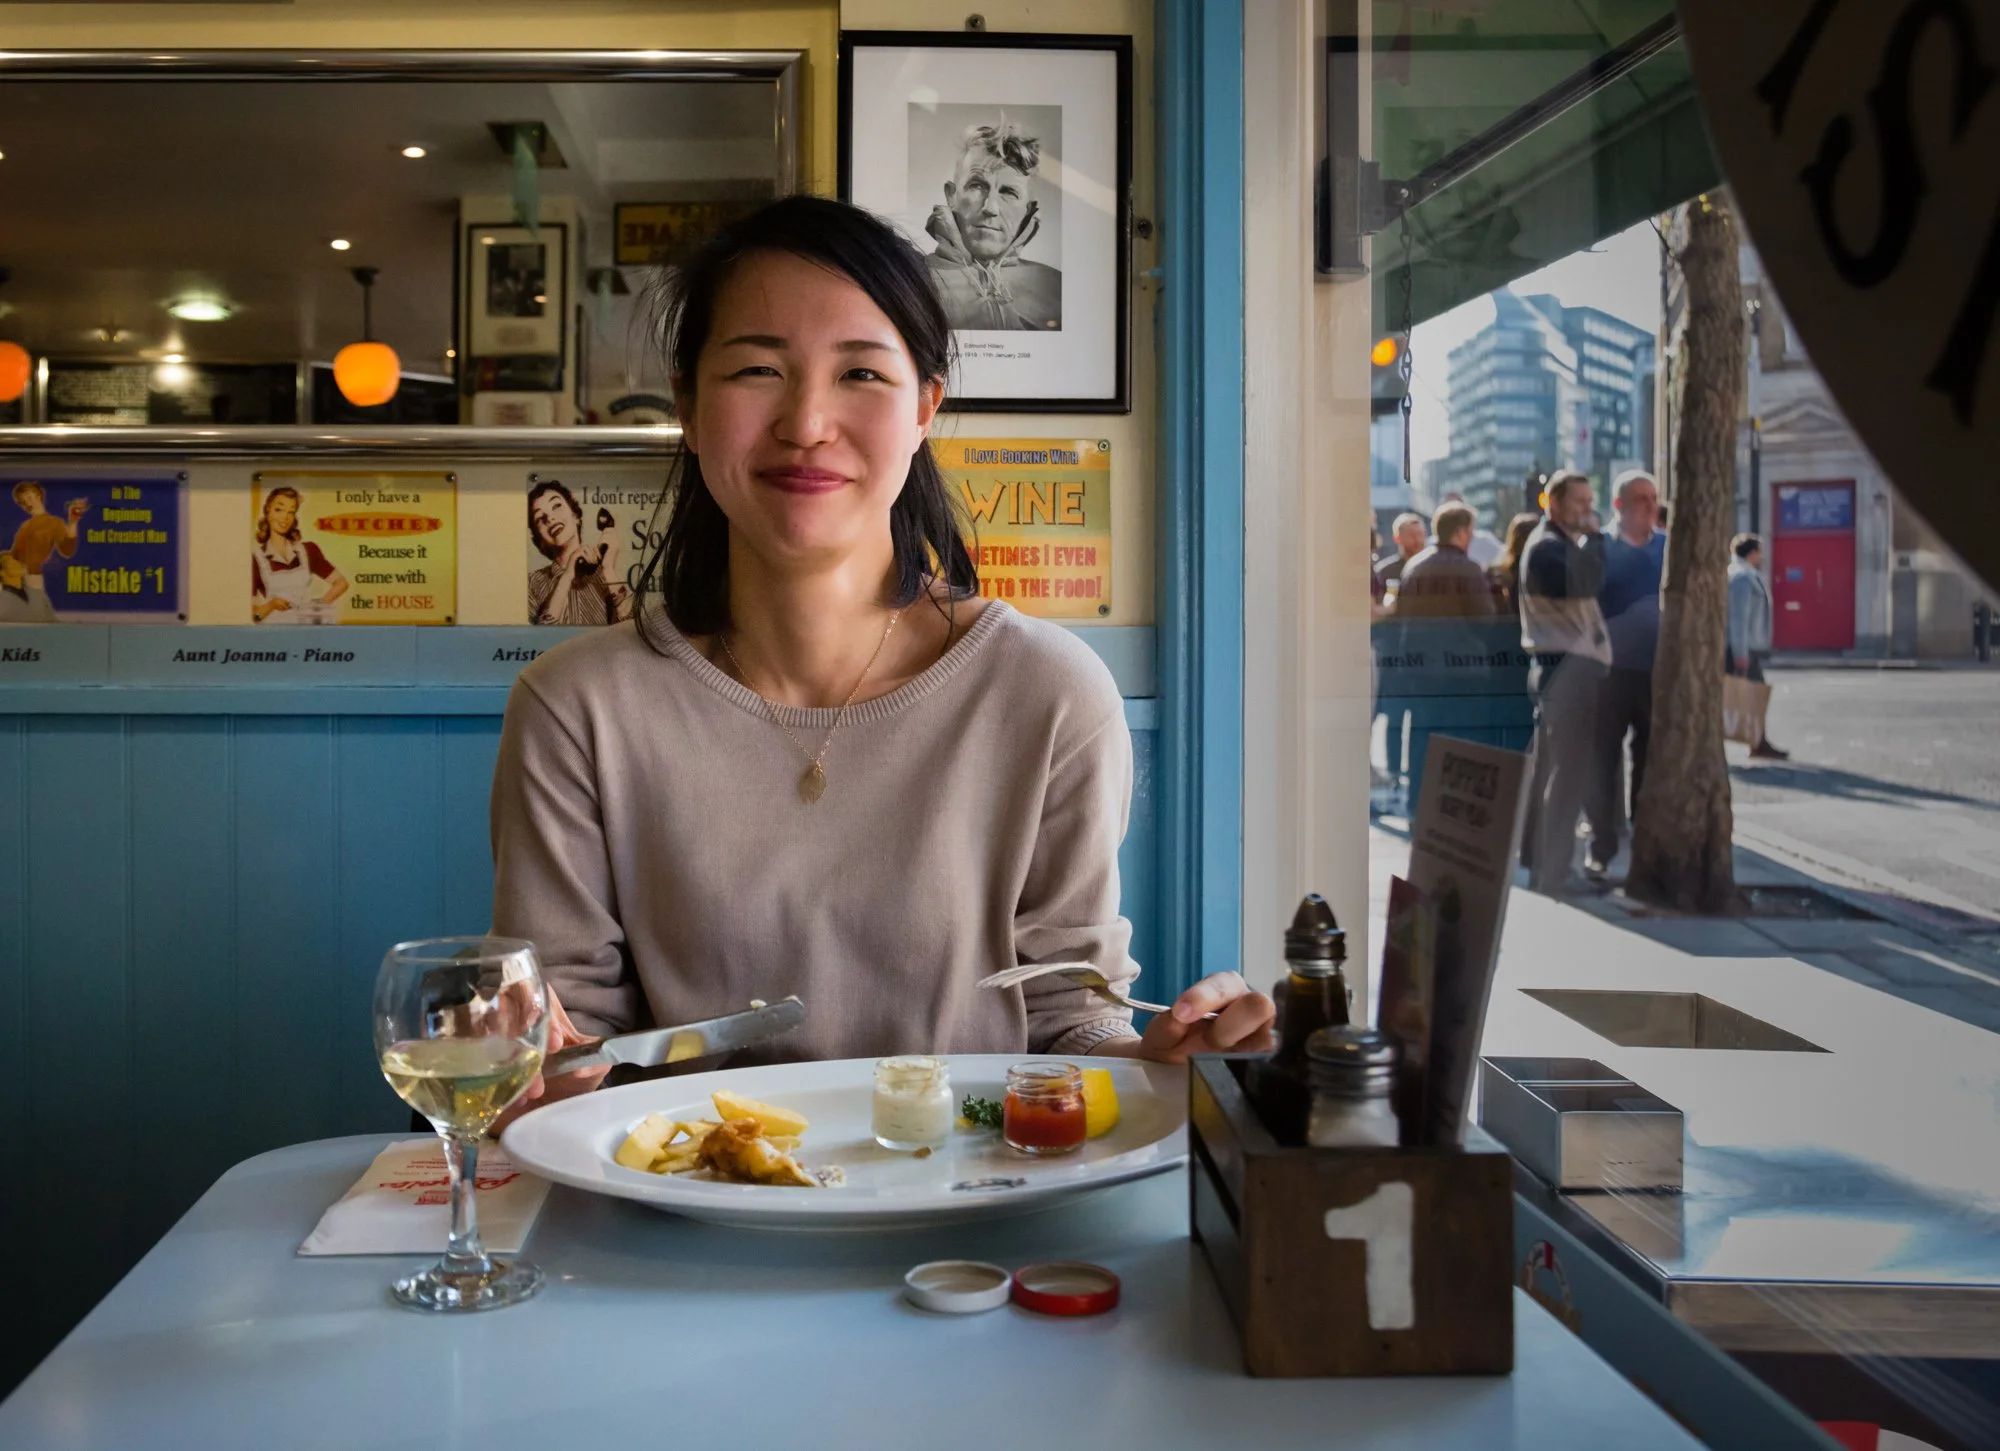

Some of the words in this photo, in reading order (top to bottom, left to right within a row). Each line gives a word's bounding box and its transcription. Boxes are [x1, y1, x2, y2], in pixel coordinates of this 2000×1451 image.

[988, 342, 1004, 350] Hillary
[964, 448, 969, 464] I
[972, 449, 998, 464] LOVE
[1001, 449, 1047, 464] COOKING
[1050, 449, 1079, 464] WITH
[336, 490, 342, 503] I
[345, 490, 374, 506] only
[378, 490, 409, 503] have
[412, 493, 421, 503] a
[582, 487, 589, 504] I
[592, 485, 624, 505] don't
[627, 490, 668, 510] repeat
[960, 479, 1086, 527] WINE
[103, 507, 152, 523] Beginning
[317, 518, 441, 531] KITCHEN
[87, 529, 106, 543] God
[107, 529, 145, 544] Created
[147, 529, 167, 544] Man
[358, 545, 415, 559] Because
[417, 544, 427, 559] it
[966, 546, 1040, 567] METIMES
[1044, 543, 1050, 566] I
[1054, 546, 1097, 567] EVEN
[67, 566, 141, 594] Mistake
[354, 572, 392, 585] came
[395, 569, 426, 585] with
[995, 577, 1016, 598] TO
[1019, 577, 1050, 598] THE
[1054, 576, 1102, 599] FOOD!
[351, 594, 374, 609] the
[377, 595, 434, 610] HOUSE
[1, 648, 41, 662] Kids
[172, 648, 216, 662] Aunt
[219, 648, 287, 664] Joanna
[303, 648, 355, 662] Piano
[492, 646, 544, 661] Arist
[1323, 1180, 1414, 1330] 1
